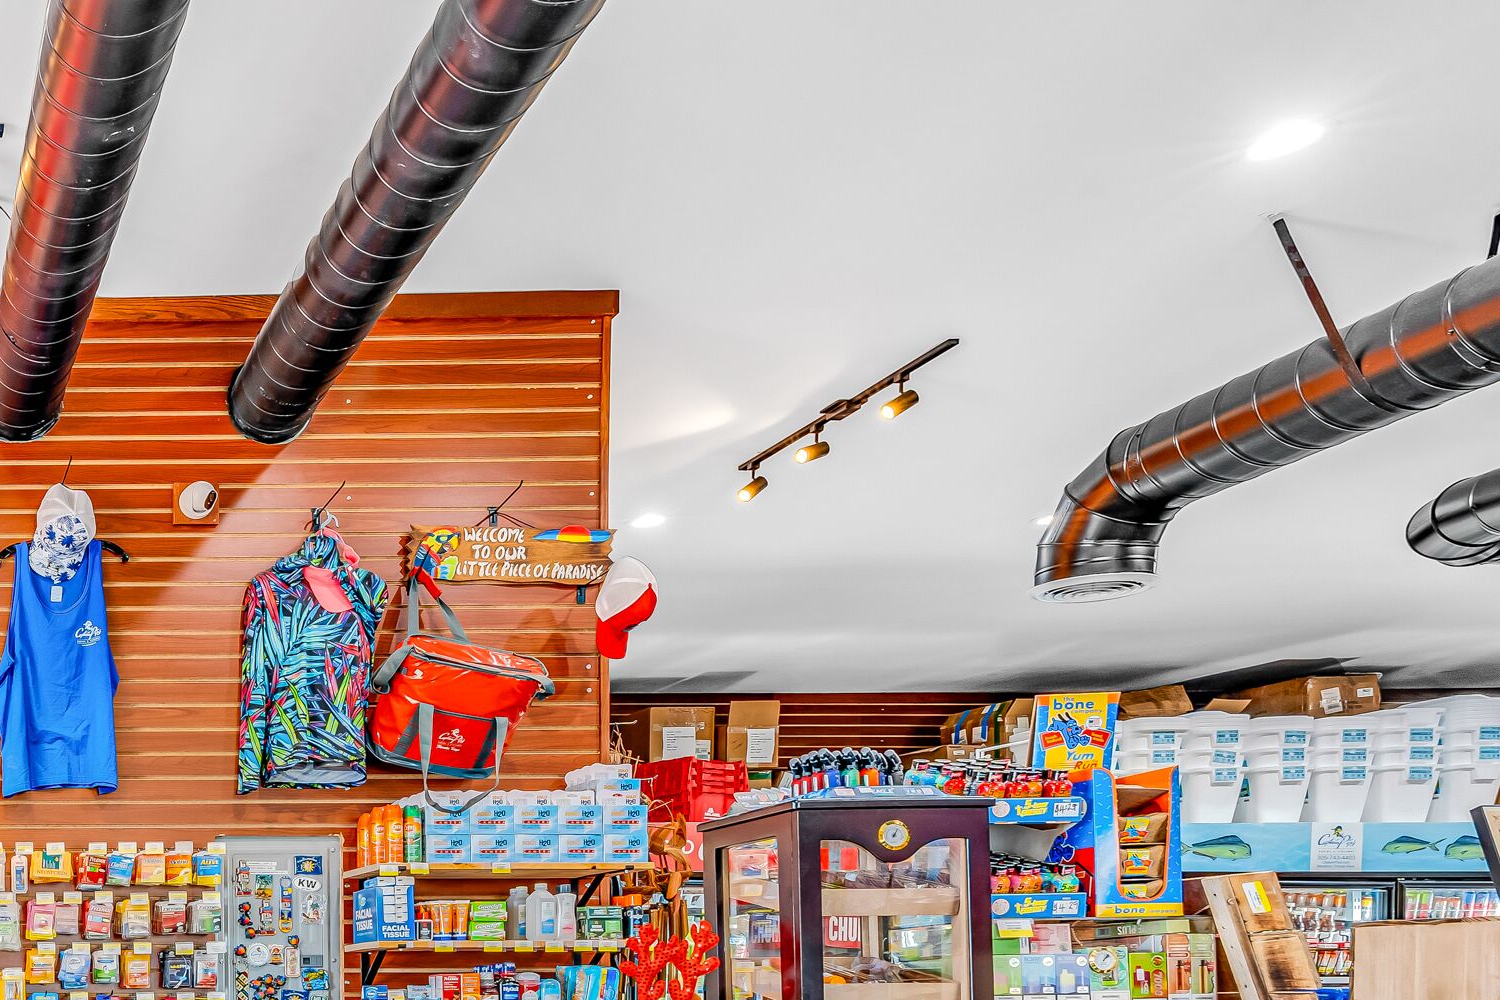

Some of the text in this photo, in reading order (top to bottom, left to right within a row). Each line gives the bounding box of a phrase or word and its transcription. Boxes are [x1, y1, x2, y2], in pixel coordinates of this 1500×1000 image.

[463, 527, 525, 544] WELCOME
[471, 544, 527, 561] TO OUR
[533, 562, 550, 578] OF
[1053, 698, 1095, 711] bone
[1066, 750, 1095, 762] Yum
[297, 878, 317, 889] KW
[1114, 904, 1146, 915] bone
[382, 924, 411, 932] FACIAL
[382, 930, 411, 938] TISSUE
